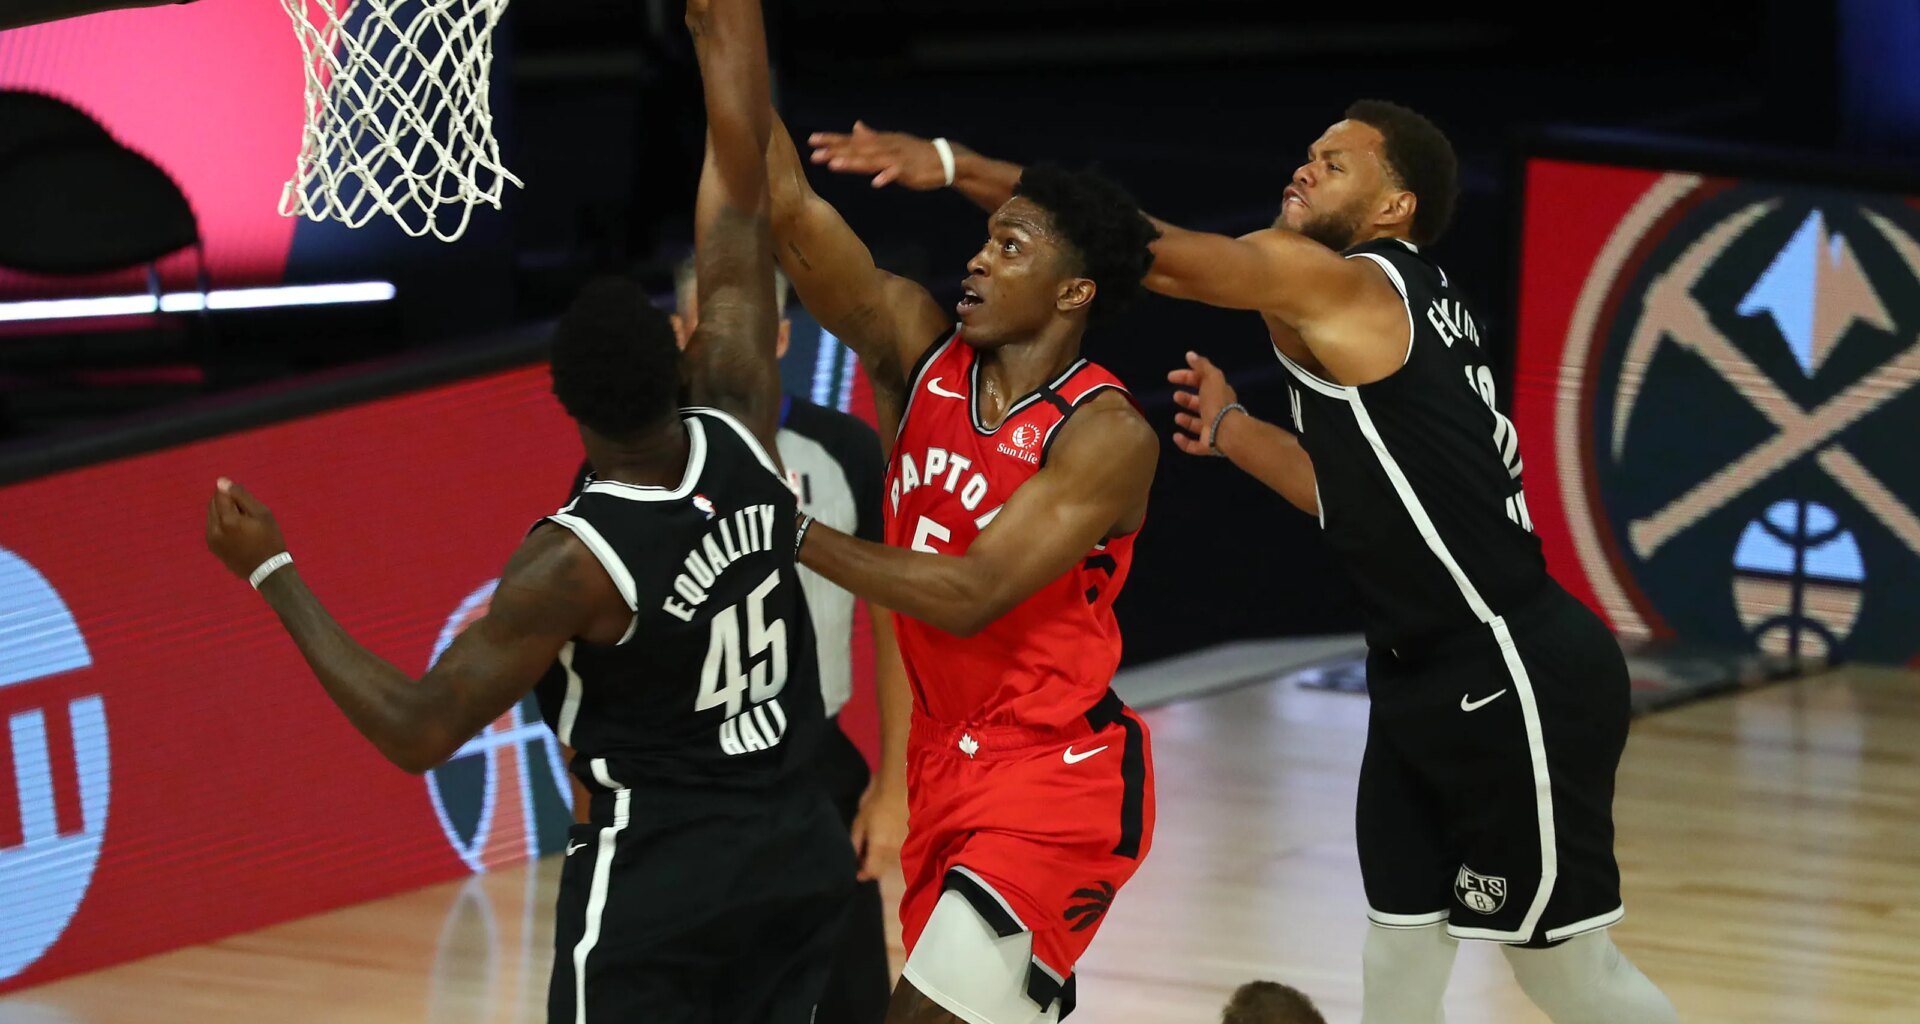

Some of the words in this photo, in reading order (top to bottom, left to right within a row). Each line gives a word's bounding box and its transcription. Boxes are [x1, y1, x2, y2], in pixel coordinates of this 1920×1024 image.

[891, 447, 1004, 531] RAPTO
[996, 442, 1017, 457] Sun
[1018, 449, 1038, 464] Life
[662, 504, 775, 622] EQUALITY
[694, 568, 788, 719] 45
[1455, 866, 1504, 897] NETS
